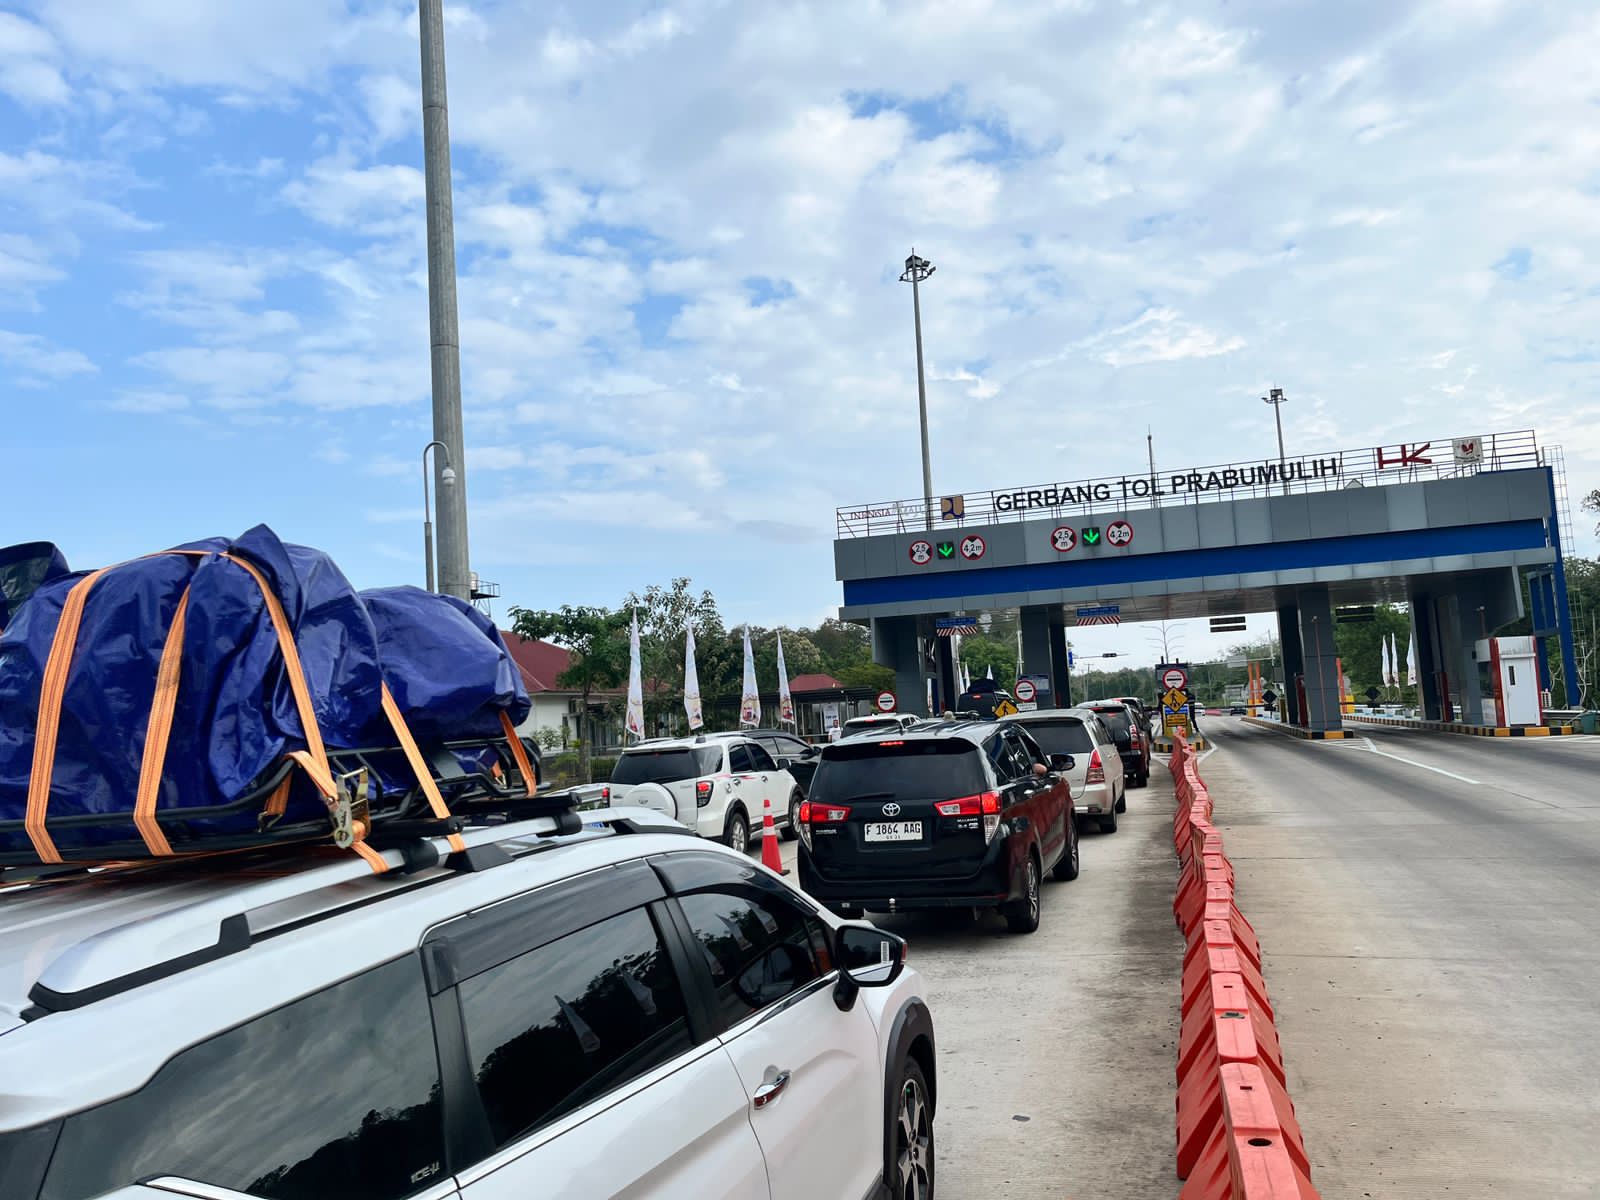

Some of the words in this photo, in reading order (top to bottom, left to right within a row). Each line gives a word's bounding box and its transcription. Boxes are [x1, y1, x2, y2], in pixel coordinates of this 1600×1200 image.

[1376, 441, 1432, 470] HK
[996, 483, 1110, 511] GERBANG
[1117, 478, 1165, 500] TOL
[1171, 457, 1337, 494] PRABUMULIH
[1058, 531, 1070, 541] 2,5
[866, 825, 872, 835] F
[876, 823, 898, 835] 1864
[904, 823, 921, 833] AAG
